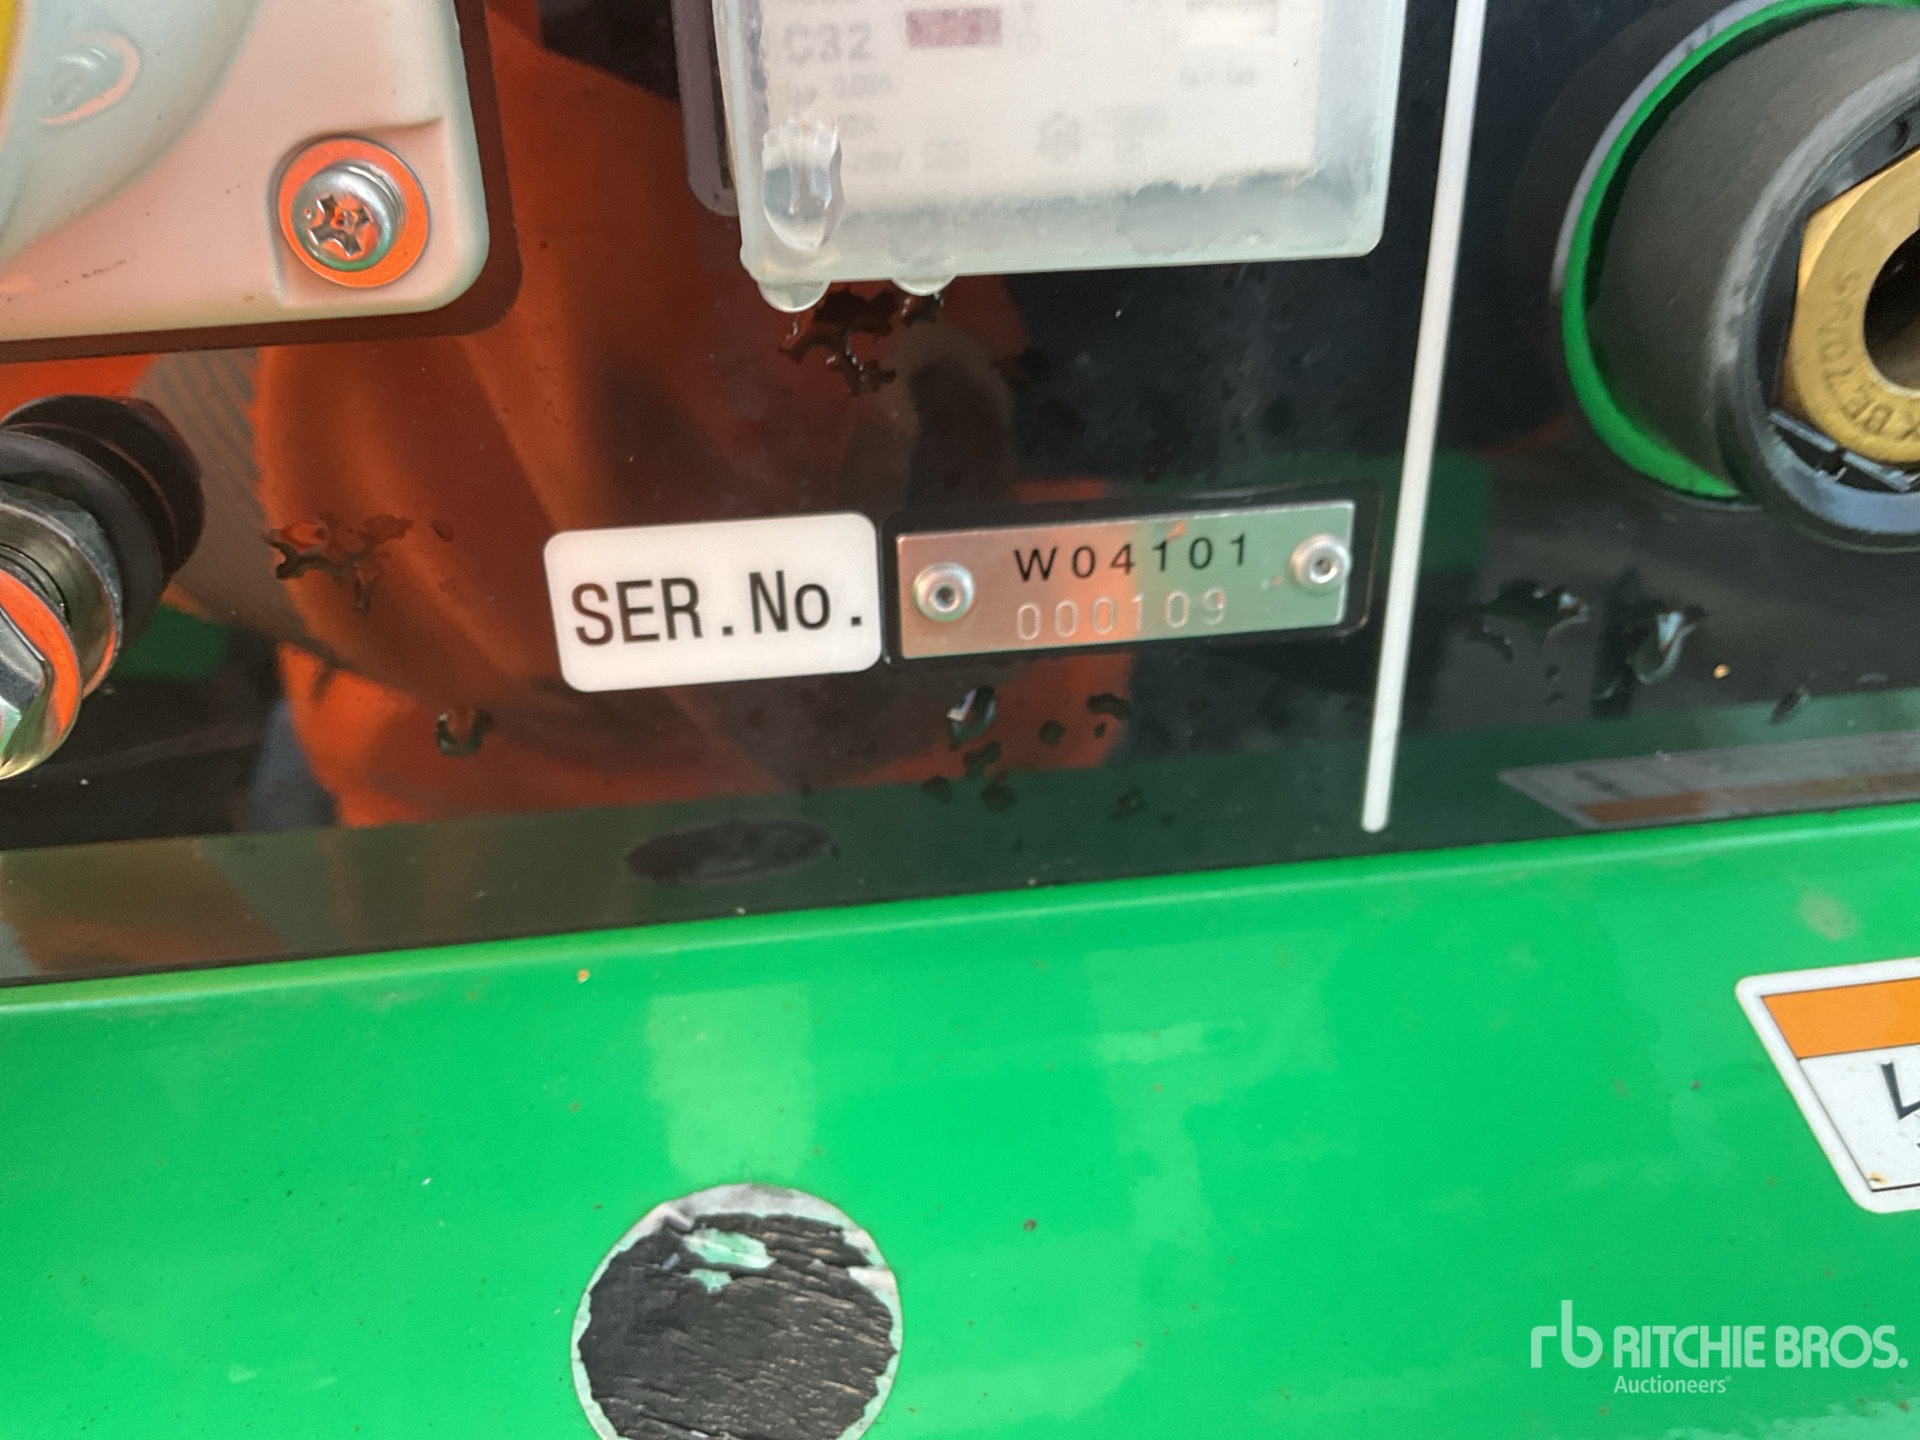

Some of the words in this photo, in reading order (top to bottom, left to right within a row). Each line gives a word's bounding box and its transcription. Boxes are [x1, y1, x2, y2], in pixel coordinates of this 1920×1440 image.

[784, 20, 871, 64] C32
[1014, 533, 1246, 583] W04101
[1016, 586, 1226, 641] 000109
